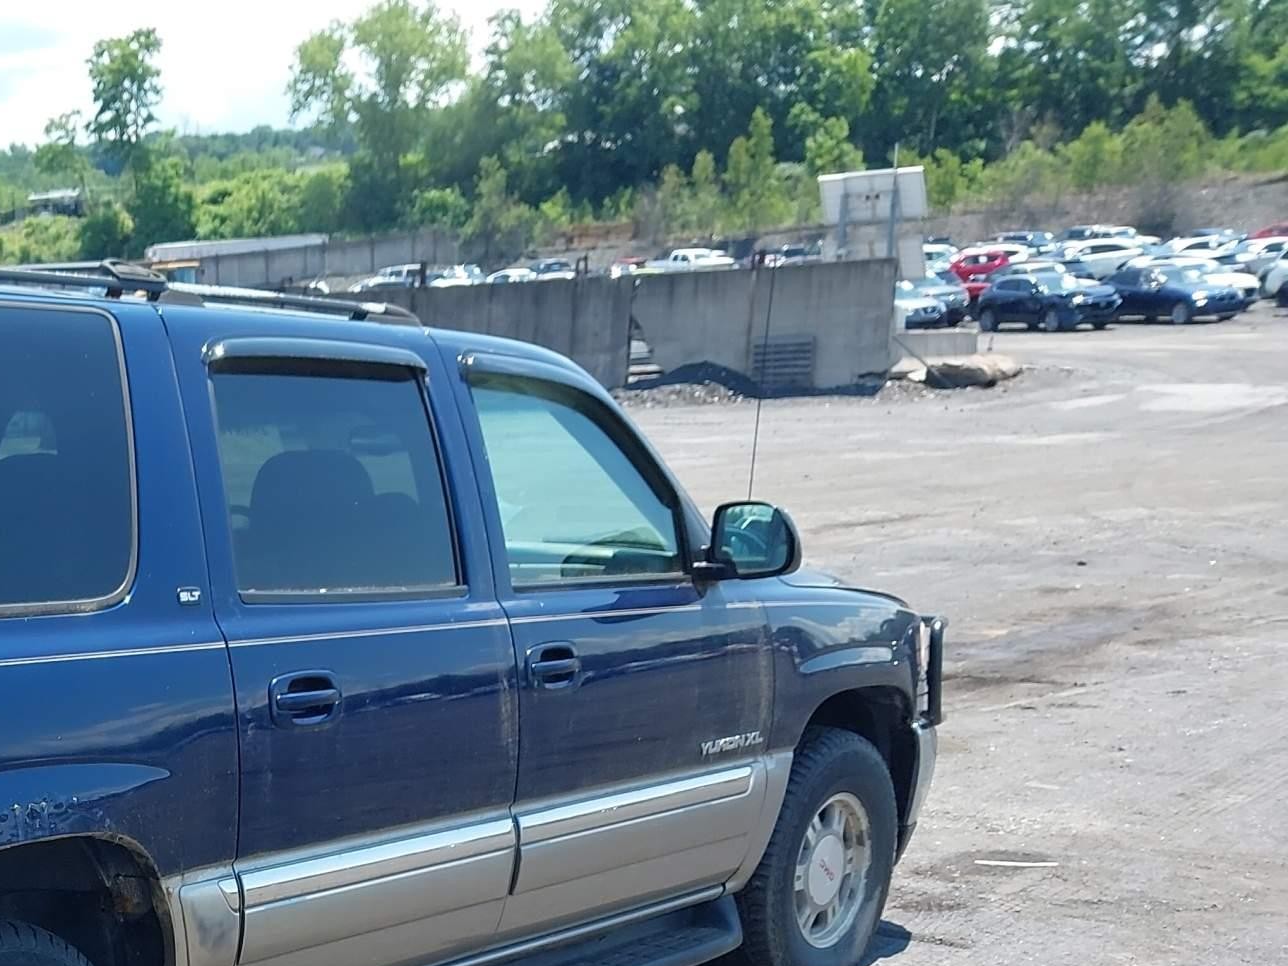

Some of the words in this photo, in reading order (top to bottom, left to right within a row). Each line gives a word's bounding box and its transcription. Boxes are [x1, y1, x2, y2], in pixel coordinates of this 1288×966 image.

[179, 590, 201, 602] SLT
[701, 735, 745, 756] YUKON
[745, 731, 764, 746] XL
